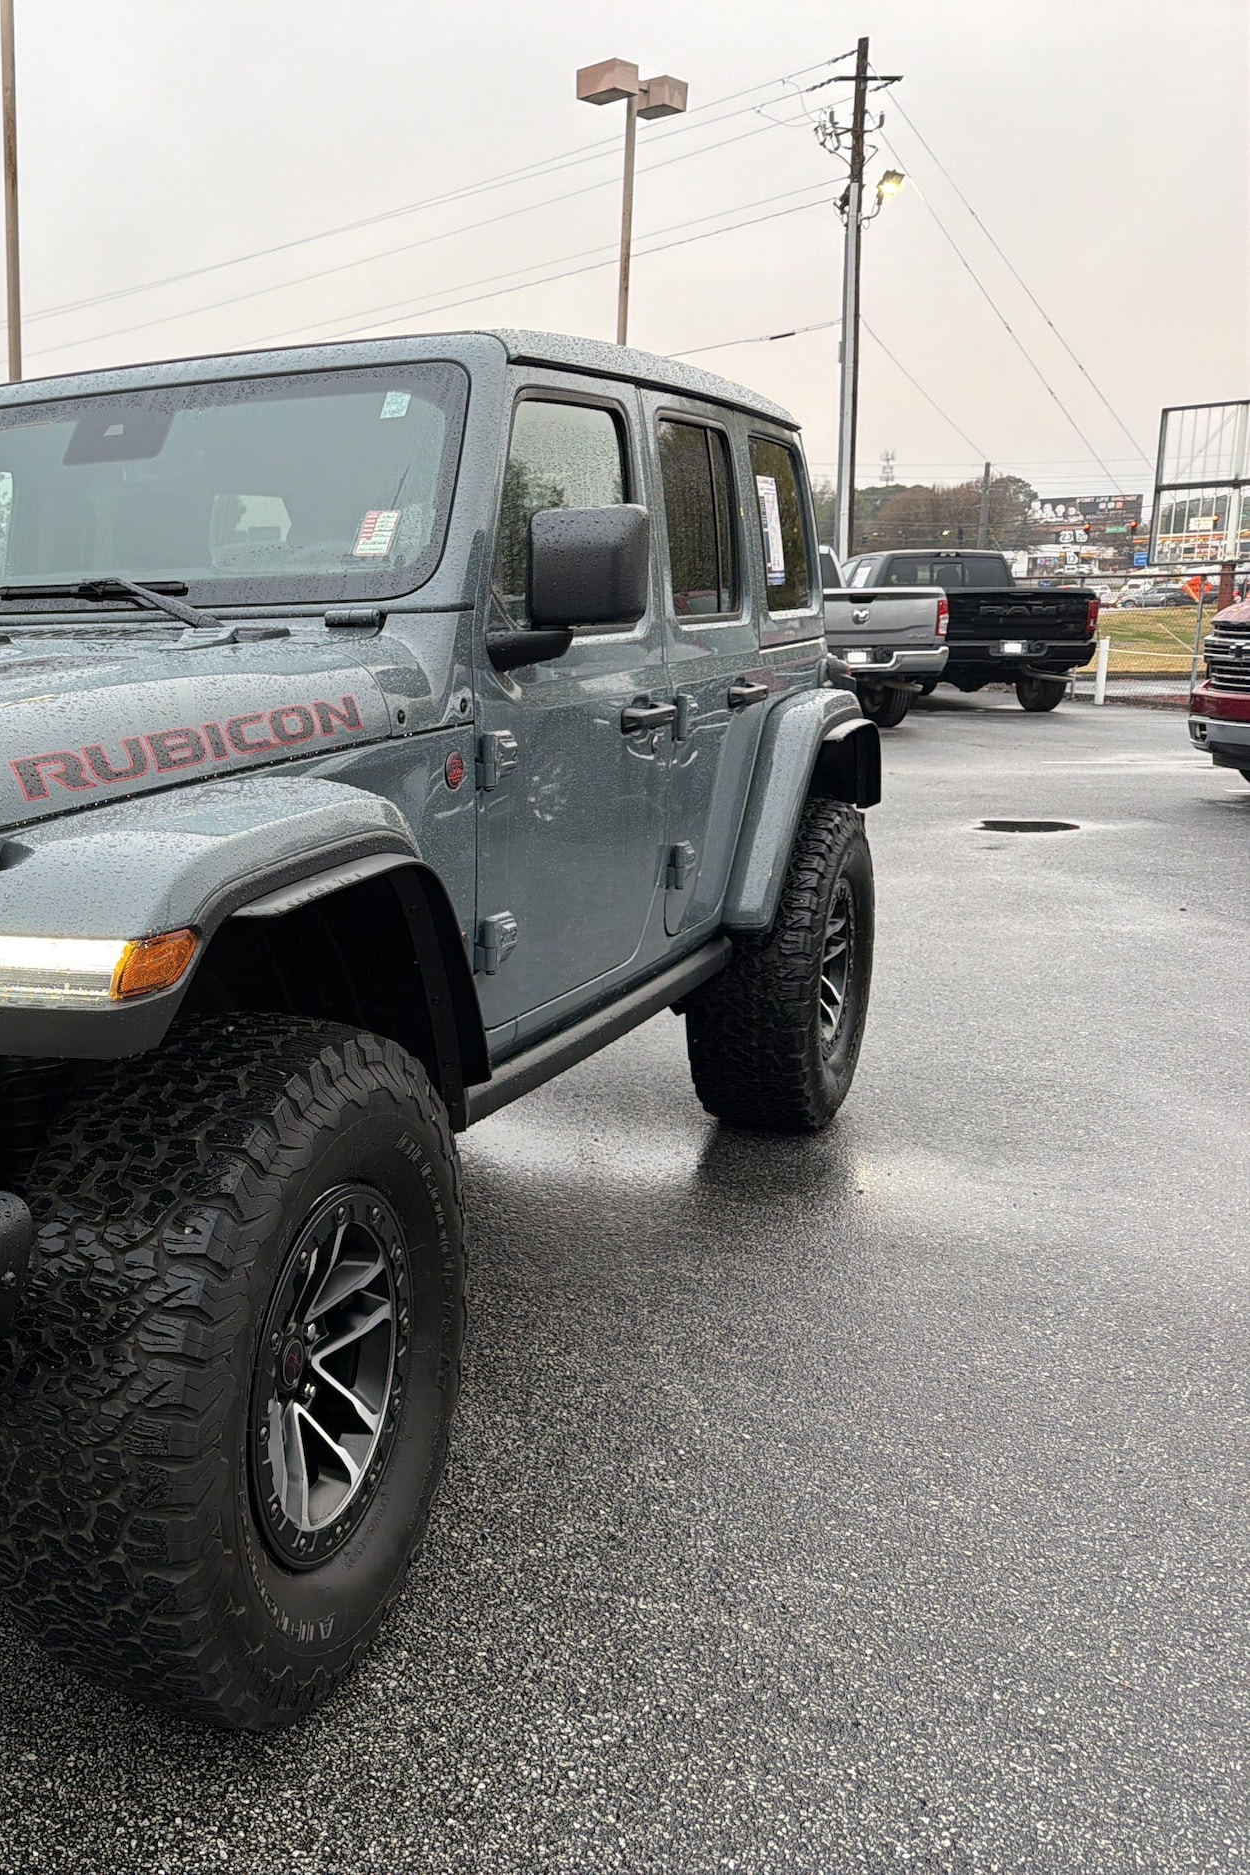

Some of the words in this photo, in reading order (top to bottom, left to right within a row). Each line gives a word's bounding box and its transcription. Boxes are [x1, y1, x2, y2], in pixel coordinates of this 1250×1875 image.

[1061, 533, 1073, 541] 23
[1077, 533, 1087, 541] 20
[1068, 555, 1076, 563] 13
[979, 605, 1057, 616] RAM
[10, 693, 364, 802] RUBICON
